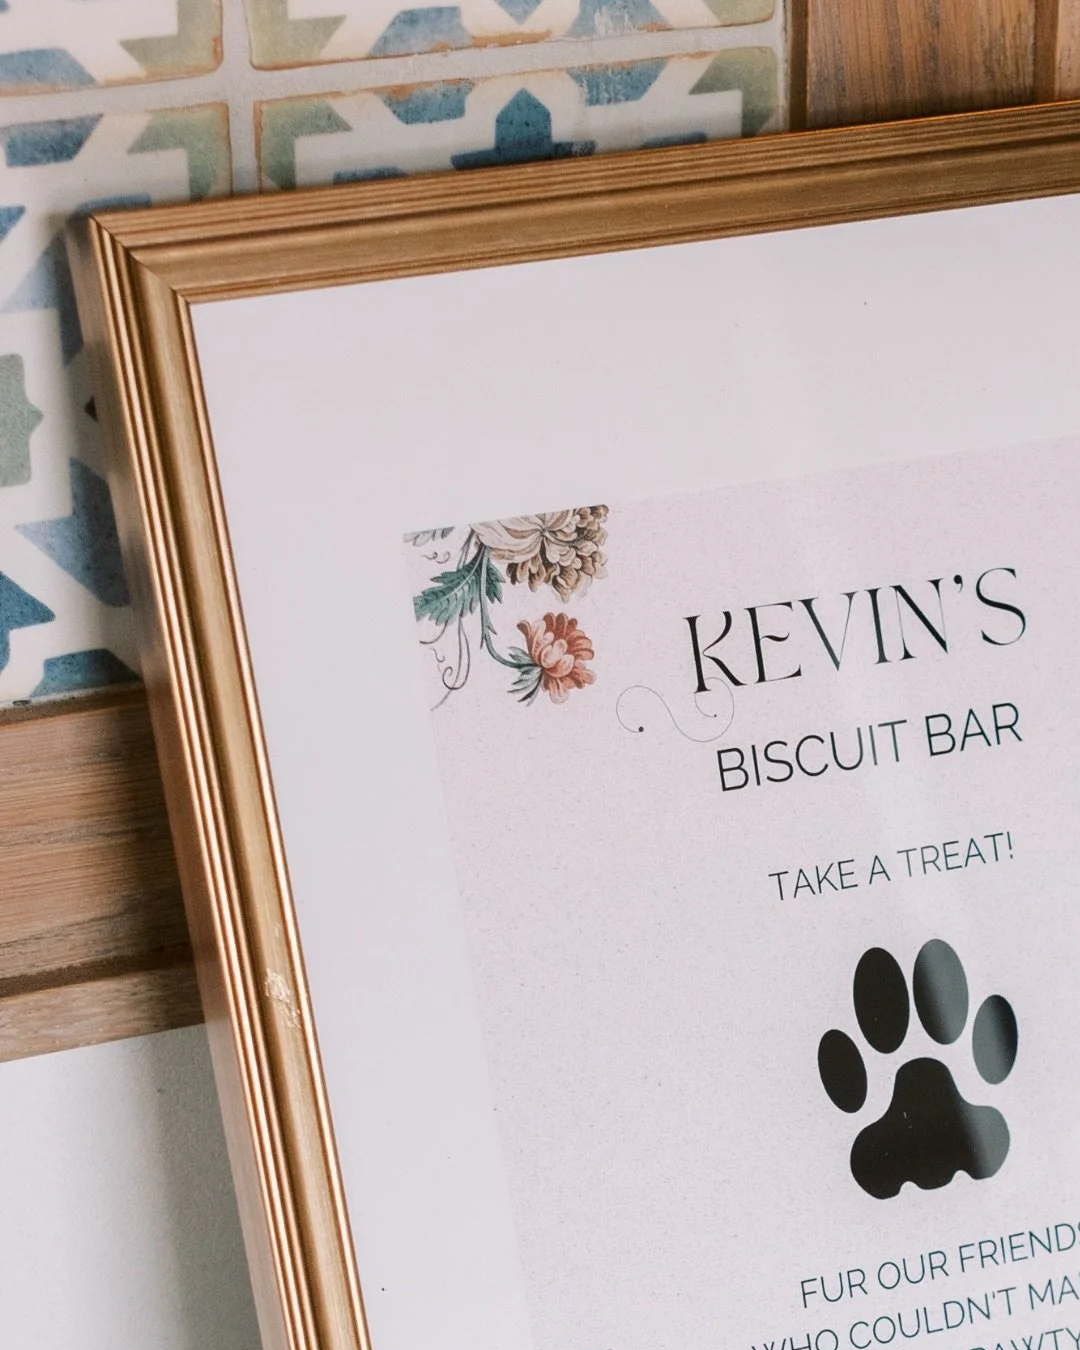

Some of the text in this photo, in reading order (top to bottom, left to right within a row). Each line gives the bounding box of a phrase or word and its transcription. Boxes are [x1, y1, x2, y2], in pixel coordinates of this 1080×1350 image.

[682, 567, 1027, 695] KEVIN'S
[716, 702, 1024, 793] BISCUIT BAR
[768, 830, 1015, 901] TAKE A TREAT!
[800, 1267, 869, 1309] FUR
[877, 1250, 950, 1290] OUR
[849, 1286, 1017, 1350] COULDN'T
